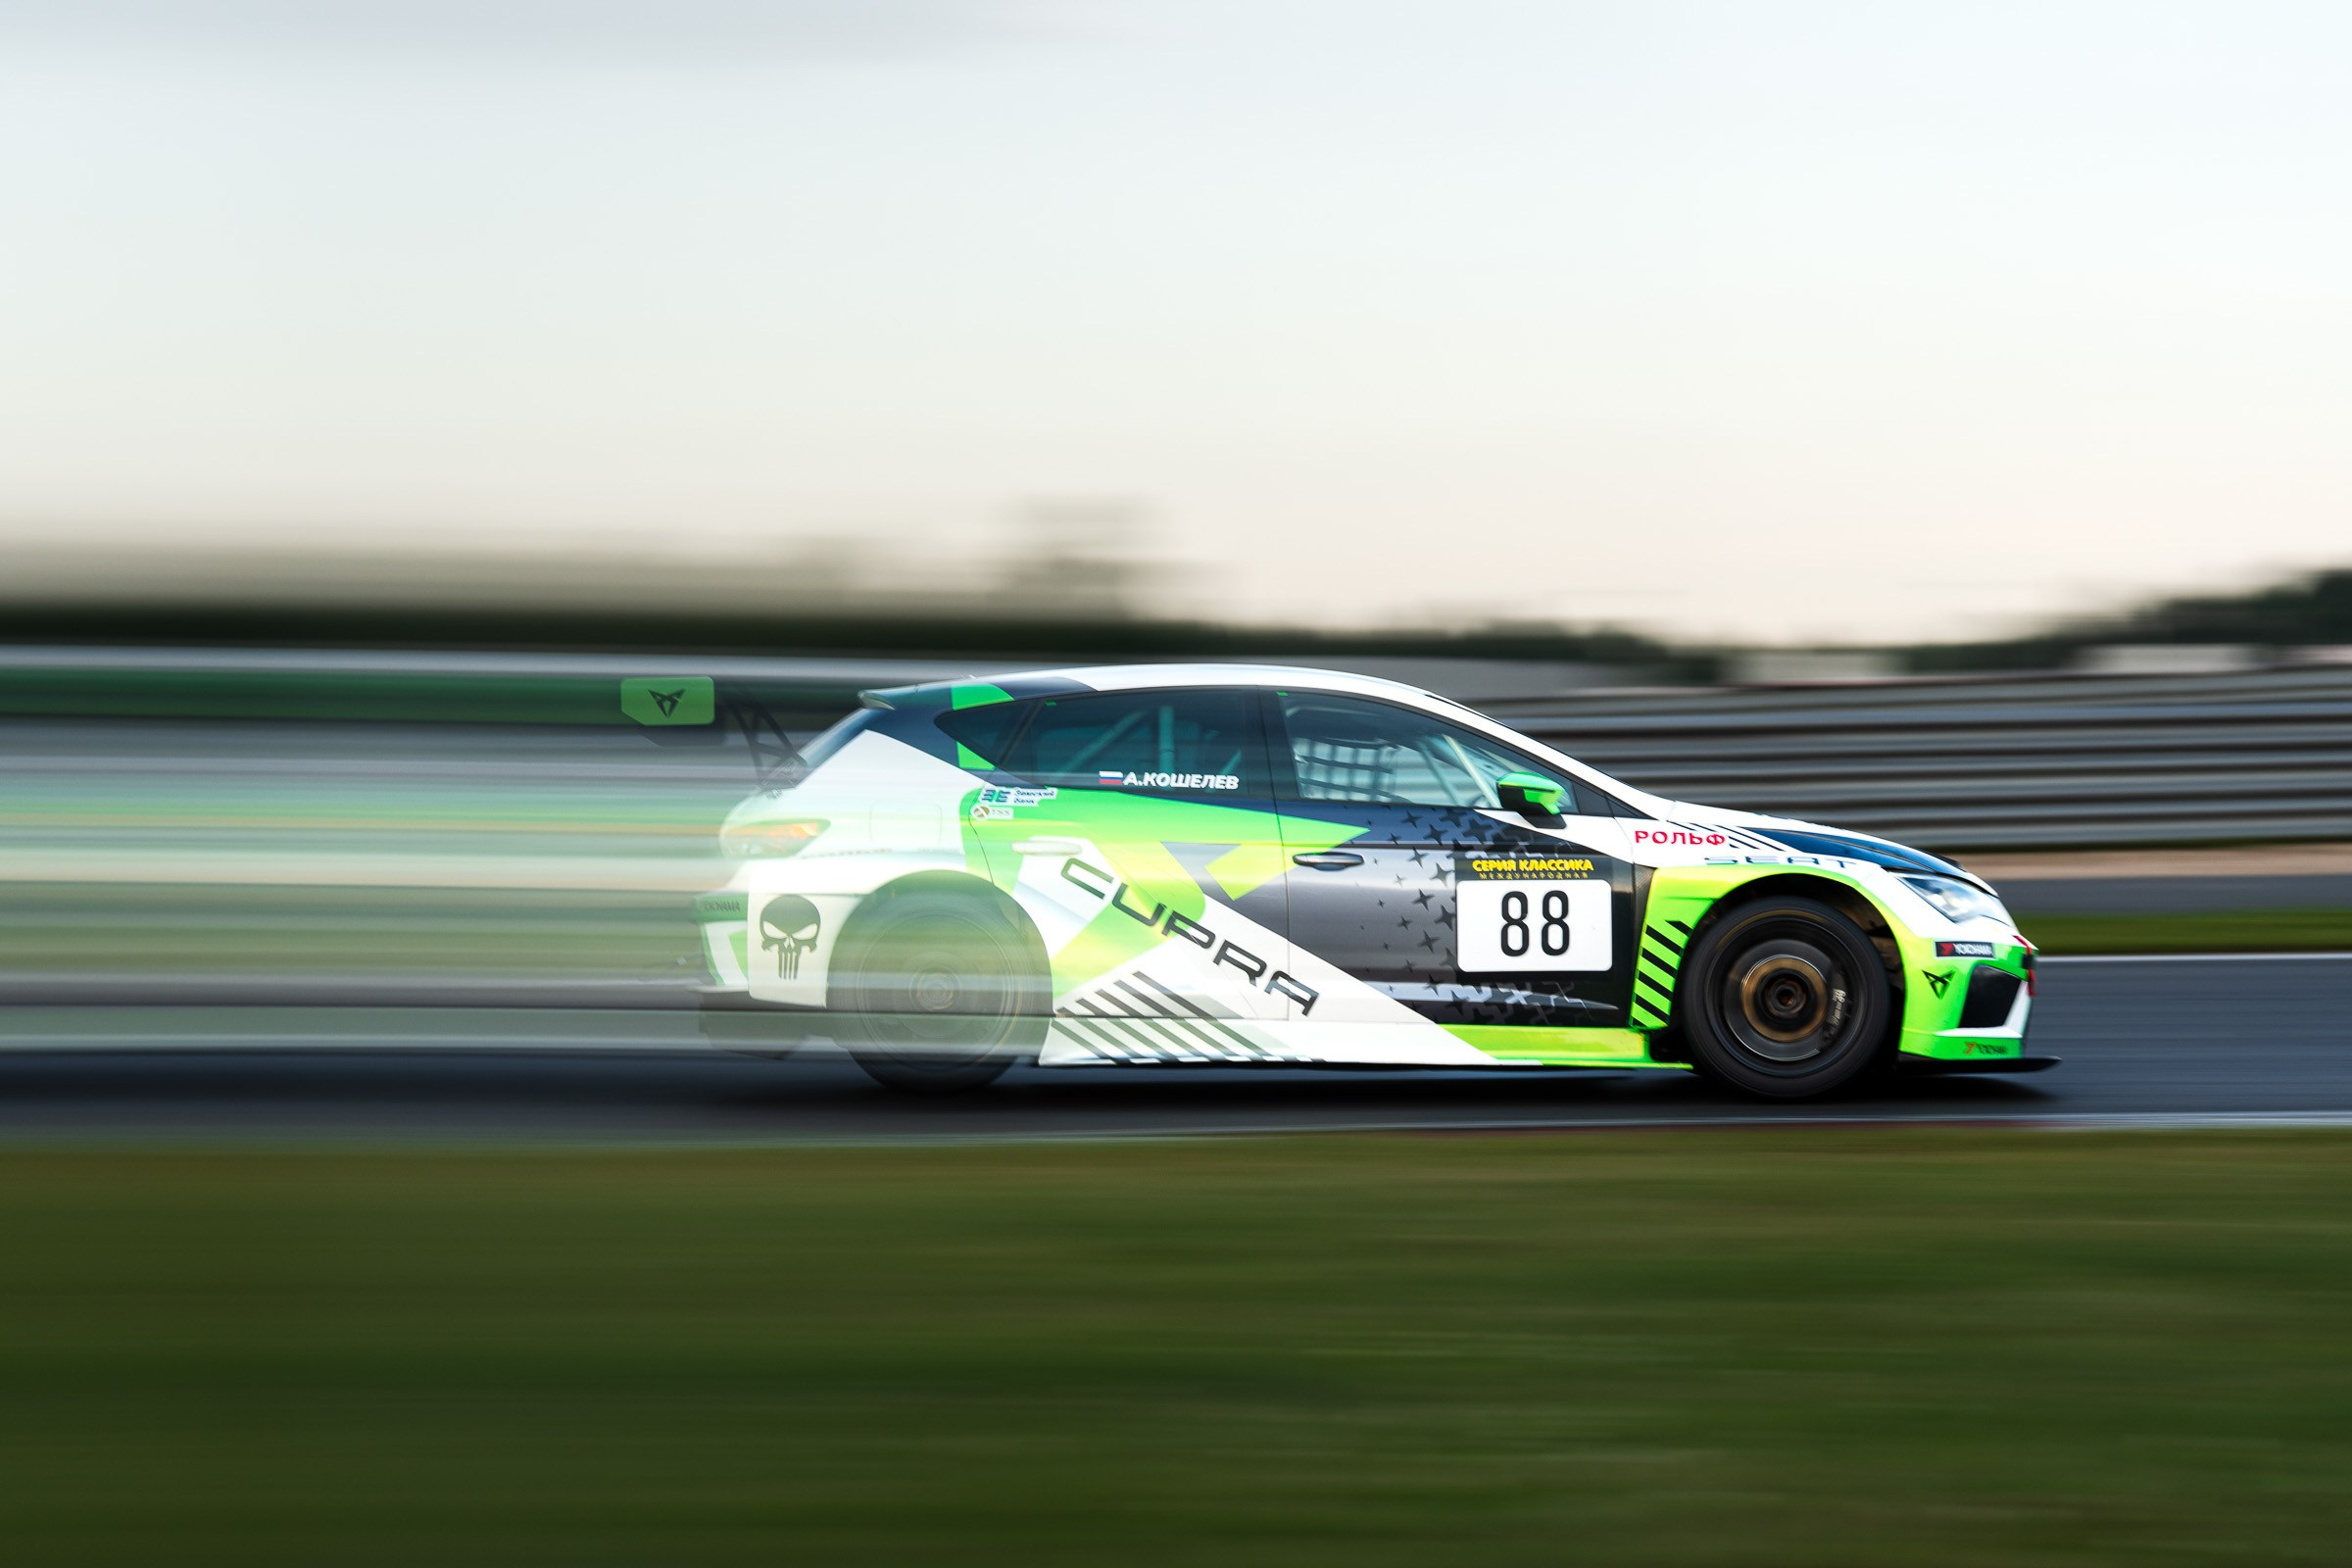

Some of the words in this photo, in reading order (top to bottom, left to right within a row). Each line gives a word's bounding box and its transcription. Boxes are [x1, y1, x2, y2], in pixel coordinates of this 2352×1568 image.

[1123, 771, 1240, 790] А.КОШЕЛЕВ
[1635, 830, 1726, 846] РОЛЬФ
[1472, 858, 1517, 872] СЕРИЯ
[1519, 858, 1594, 871] КЛАССИКА
[1704, 855, 1857, 869] SEAT
[1479, 871, 1590, 880] МЕЖДУНАРОДНАЯ
[1500, 890, 1570, 957] 88
[1060, 858, 1319, 1016] CUPRA
